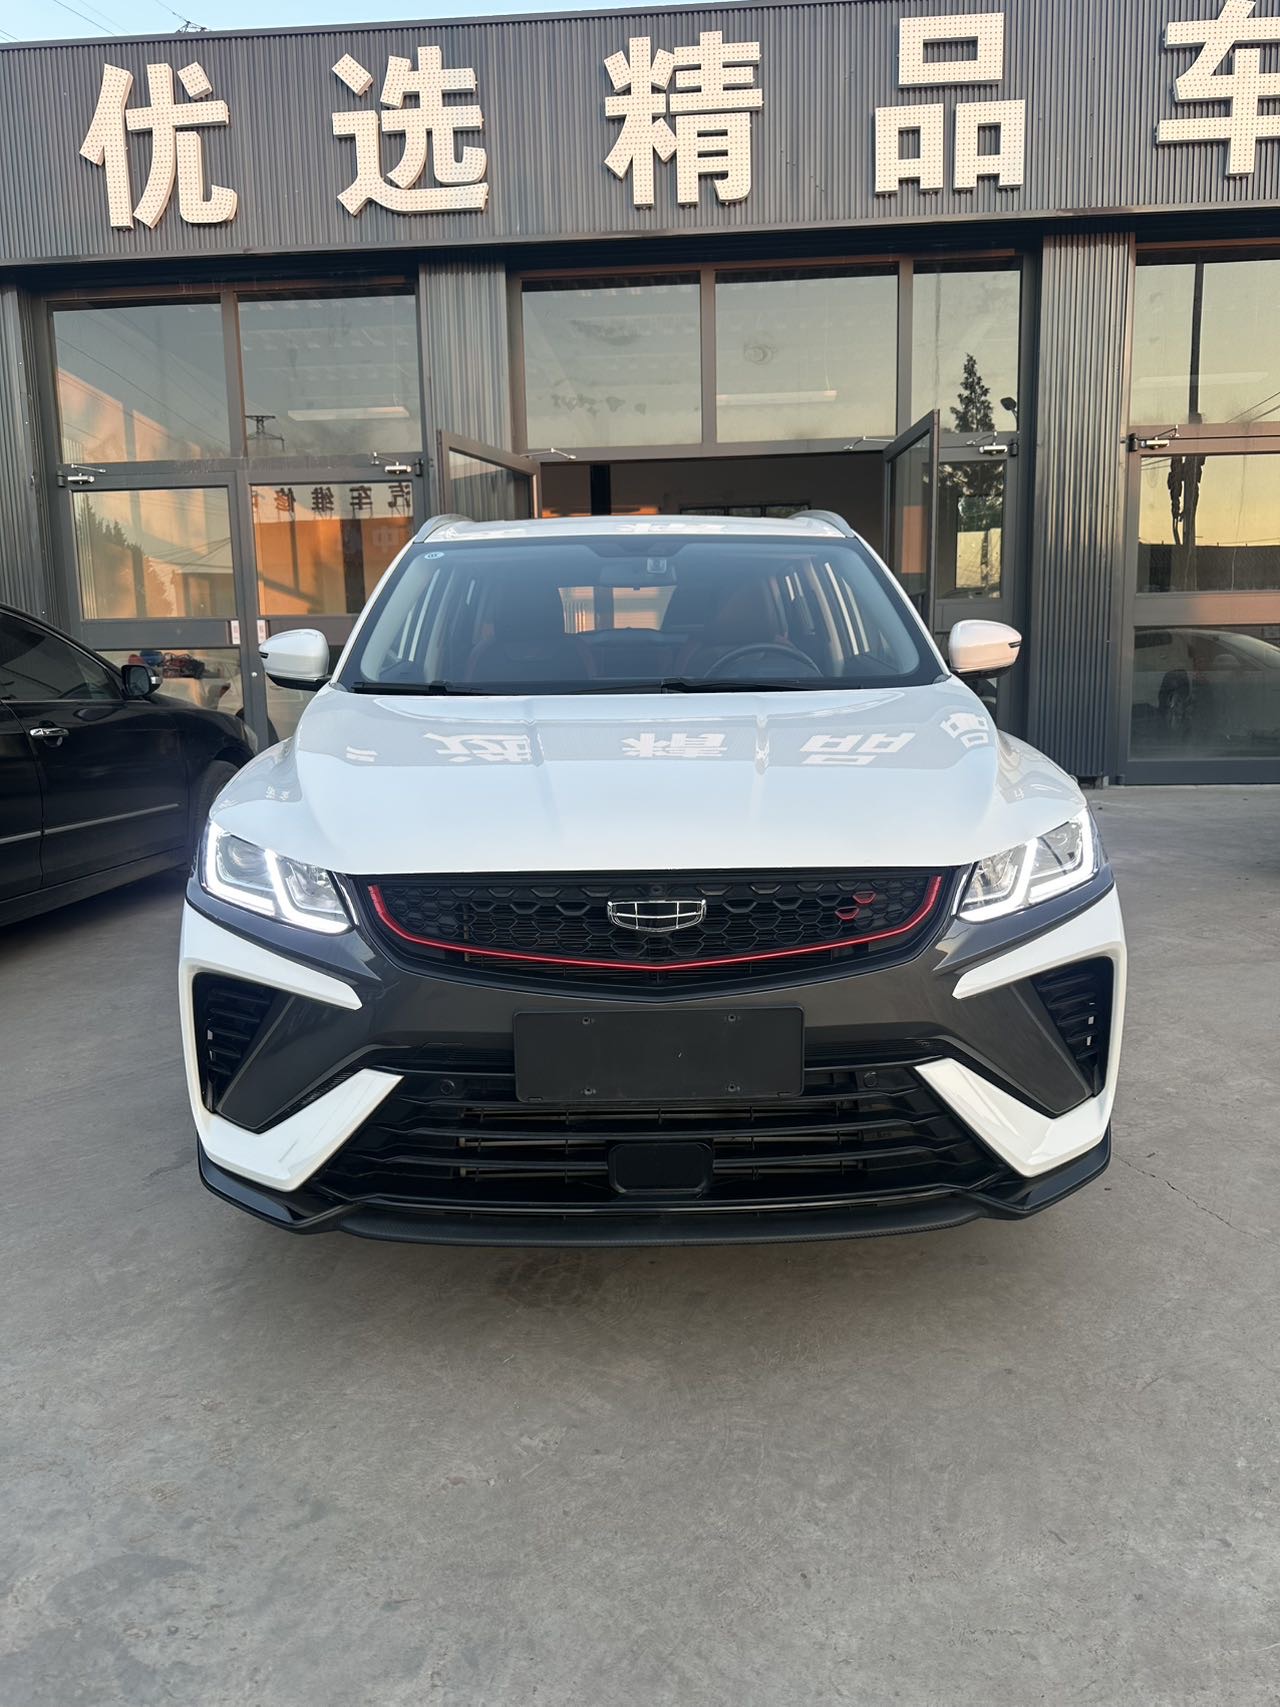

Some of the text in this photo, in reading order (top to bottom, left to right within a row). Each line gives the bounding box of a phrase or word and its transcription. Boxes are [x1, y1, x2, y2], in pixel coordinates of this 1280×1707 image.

[79, 0, 1280, 229] 优选精品车
